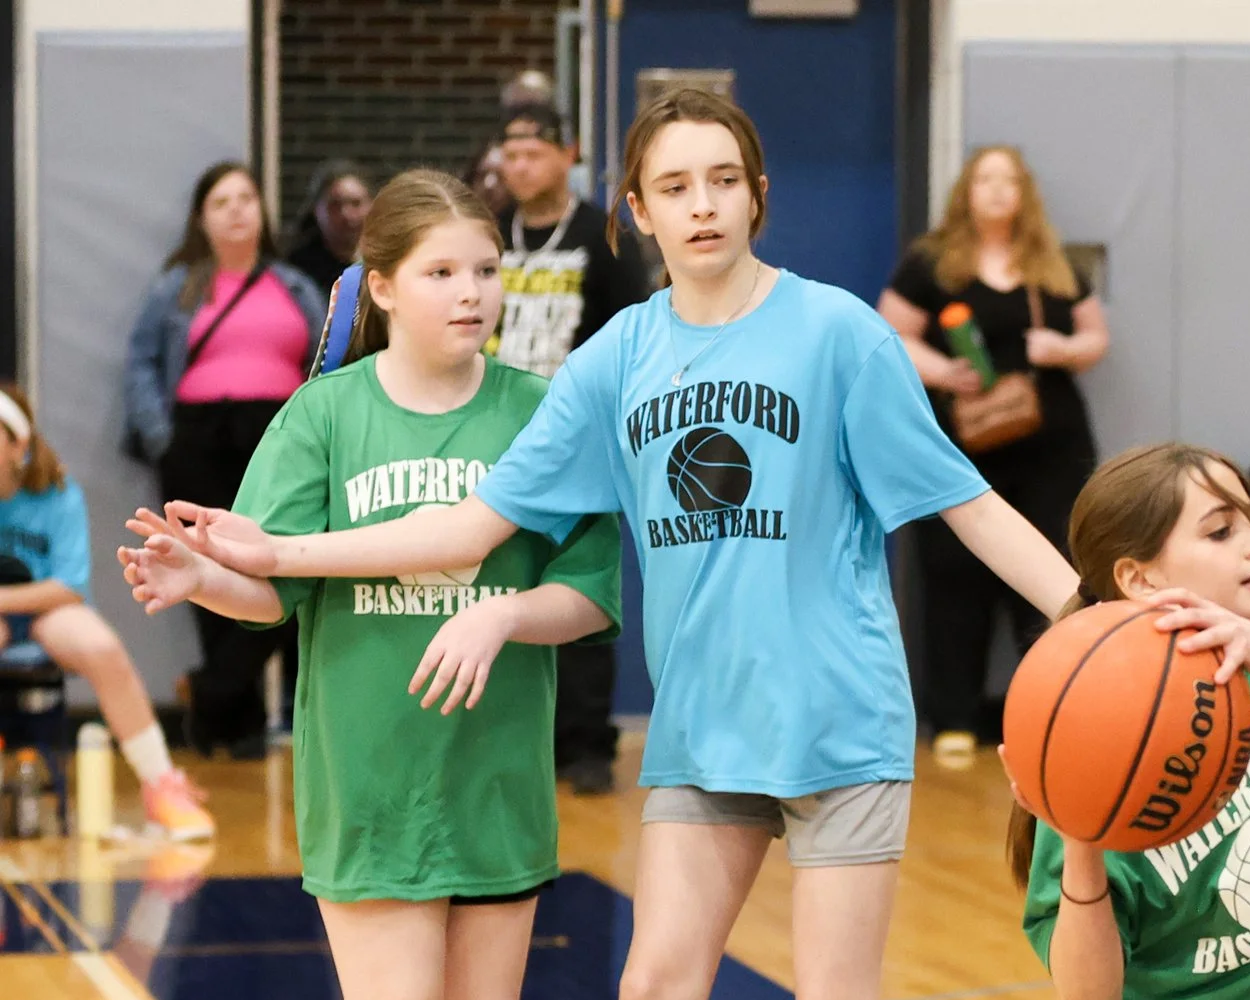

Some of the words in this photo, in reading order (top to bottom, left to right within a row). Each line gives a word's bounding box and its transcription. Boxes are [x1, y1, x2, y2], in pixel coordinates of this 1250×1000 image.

[626, 380, 800, 459] WATERFORD
[344, 456, 496, 524] WATERFO
[646, 508, 787, 549] BASKETBALL
[1128, 678, 1217, 834] Wilson
